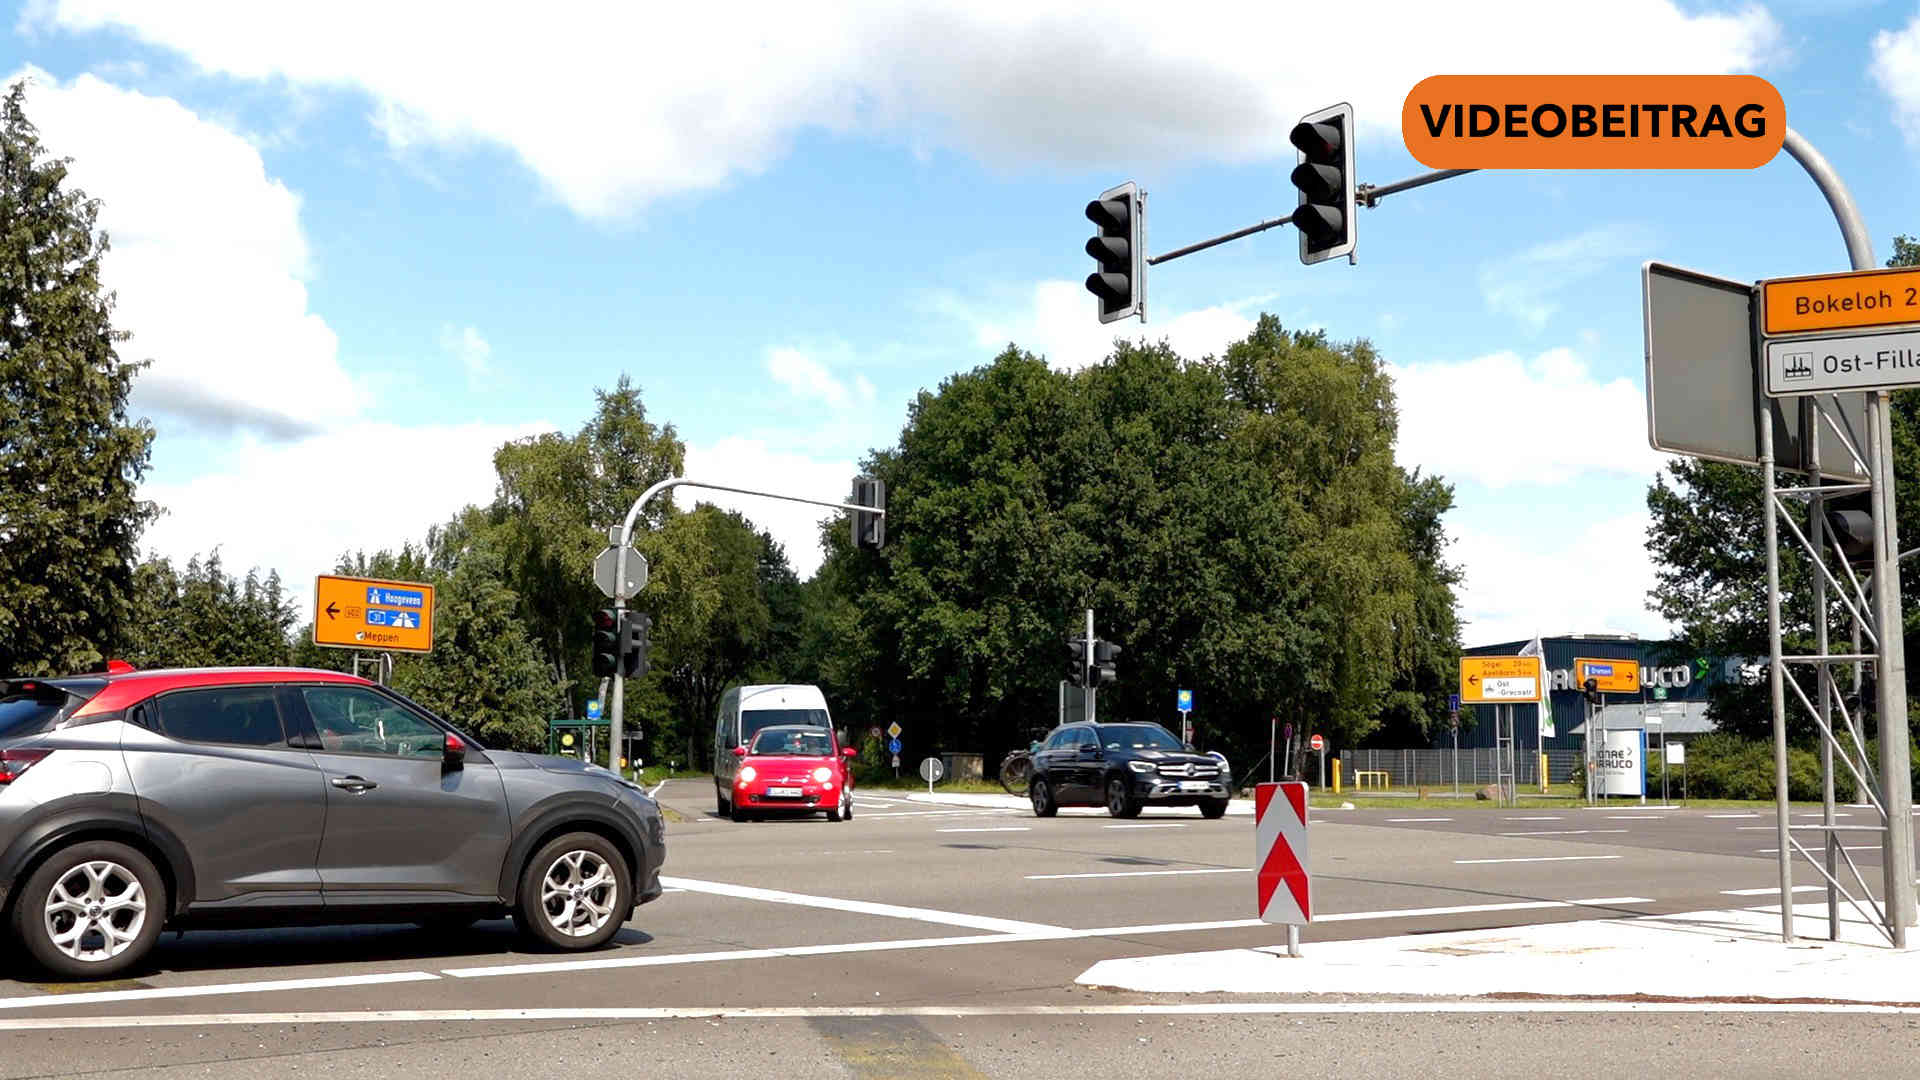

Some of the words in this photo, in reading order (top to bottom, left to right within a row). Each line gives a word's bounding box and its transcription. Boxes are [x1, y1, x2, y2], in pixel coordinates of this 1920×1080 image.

[1796, 289, 1892, 315] Bokeloh
[1904, 287, 1917, 306] 2
[364, 631, 400, 643] Meppen
